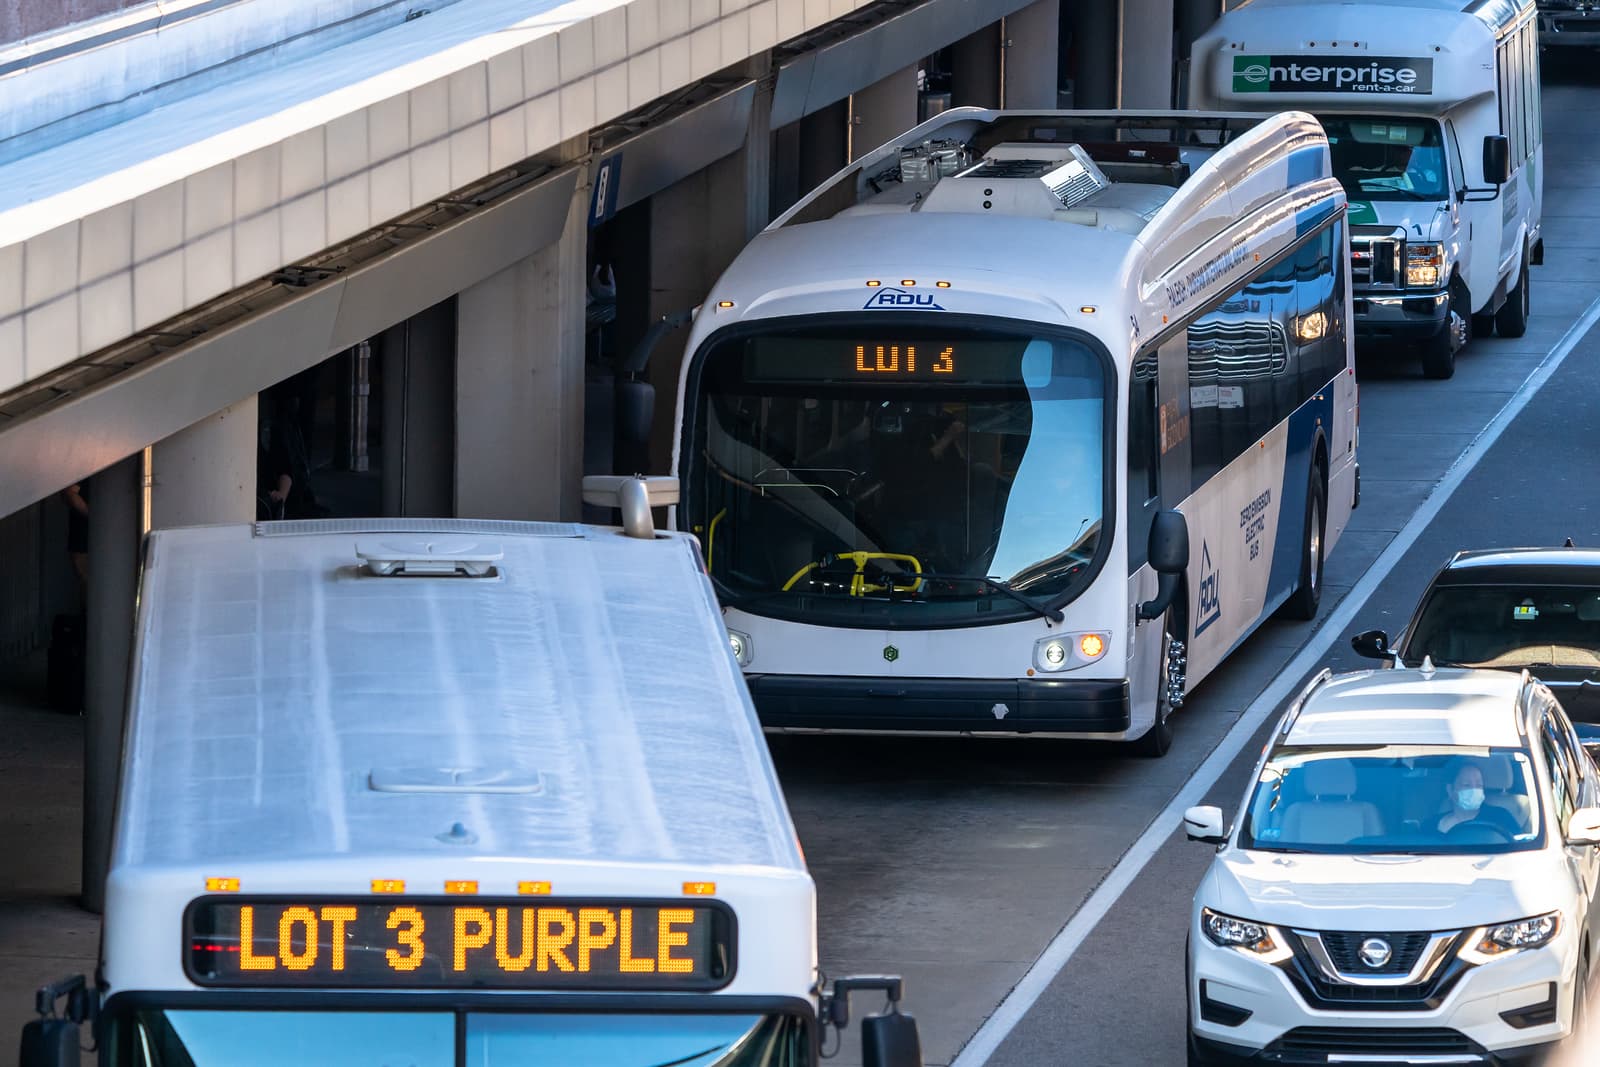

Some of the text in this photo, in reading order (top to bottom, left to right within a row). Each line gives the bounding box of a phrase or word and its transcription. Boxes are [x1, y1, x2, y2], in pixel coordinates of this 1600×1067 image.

[1242, 62, 1417, 88] enterprise
[1352, 83, 1416, 93] rent-a-car
[878, 294, 934, 306] RDU
[1249, 539, 1259, 561] BUS
[1199, 568, 1220, 619] RDU
[239, 905, 695, 973] LOT 3 PURPLE
